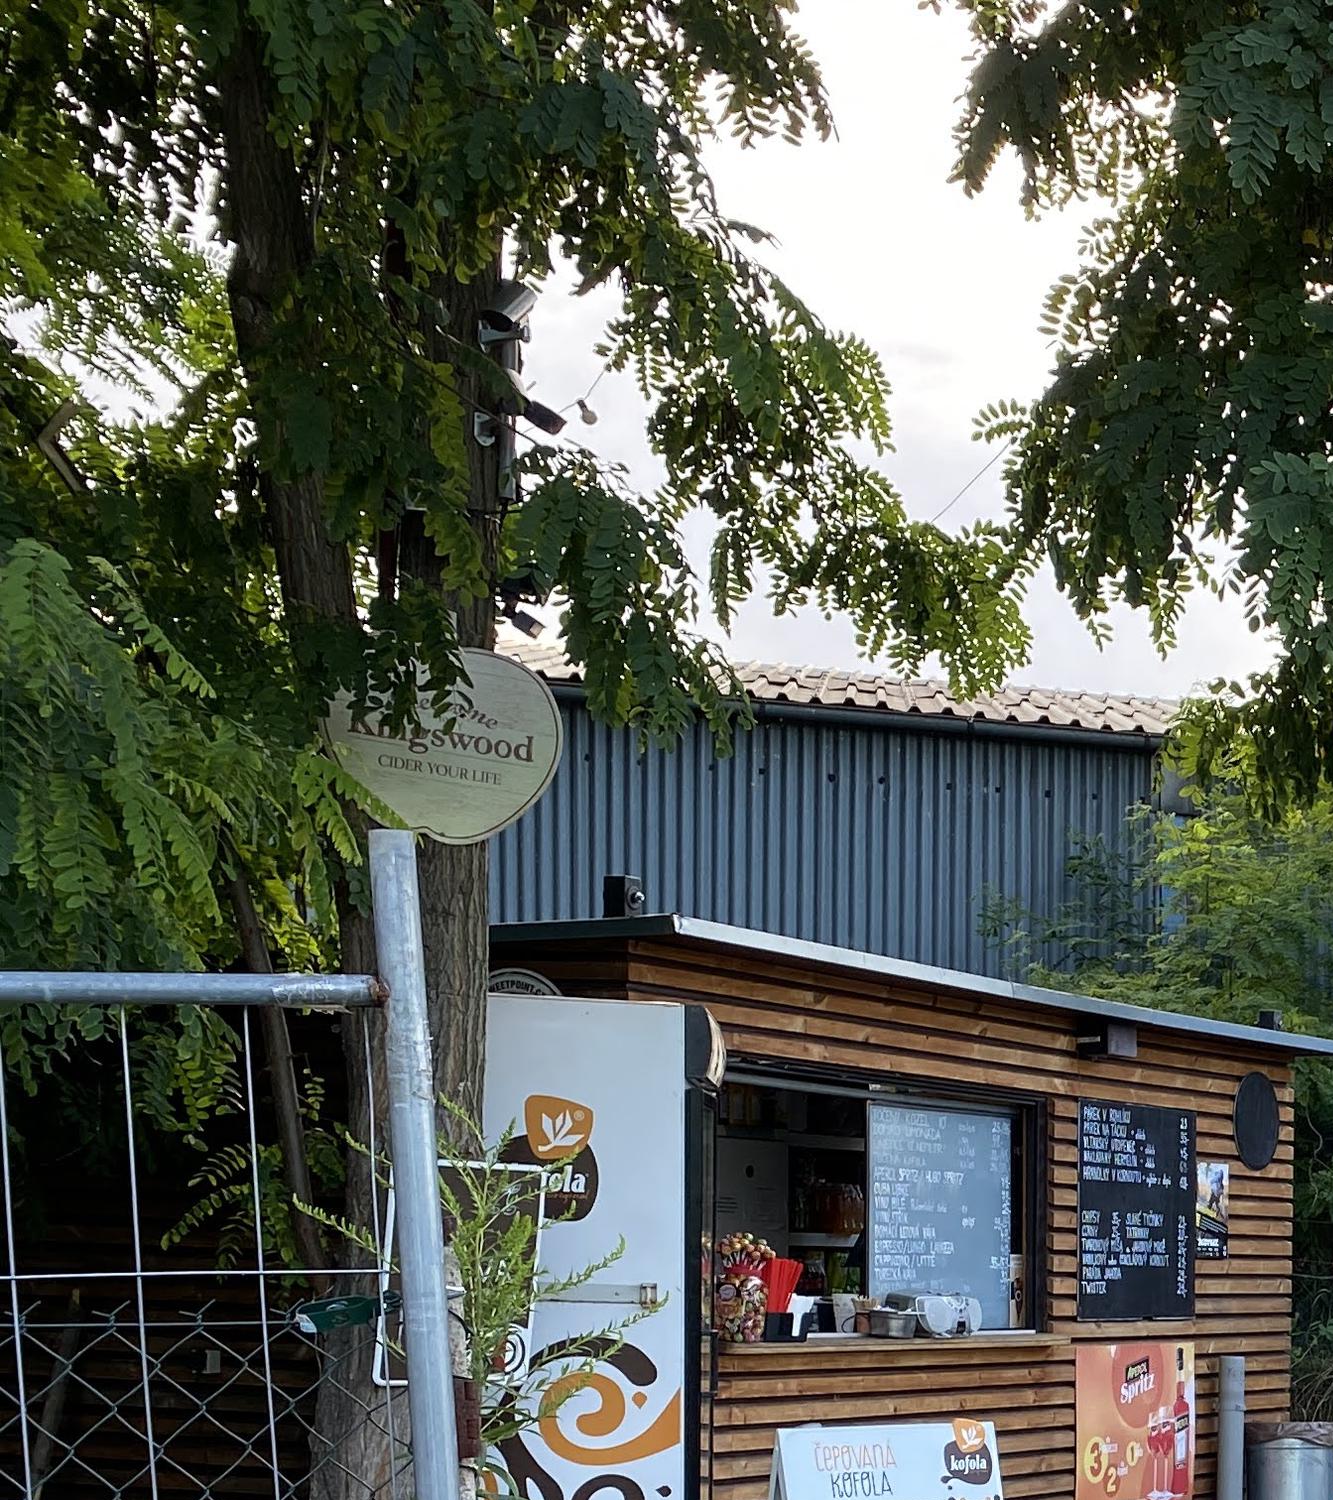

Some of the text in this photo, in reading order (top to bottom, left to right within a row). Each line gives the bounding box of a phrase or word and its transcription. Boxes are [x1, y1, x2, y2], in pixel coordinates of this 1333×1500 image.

[378, 754, 501, 785] CIDER YOUR LIFE
[1081, 1281, 1106, 1295] TWISTER
[1121, 1373, 1155, 1404] Spritz
[950, 1454, 987, 1474] kofola
[831, 1471, 893, 1498] KOFOLA
[1107, 1467, 1117, 1492] 2
